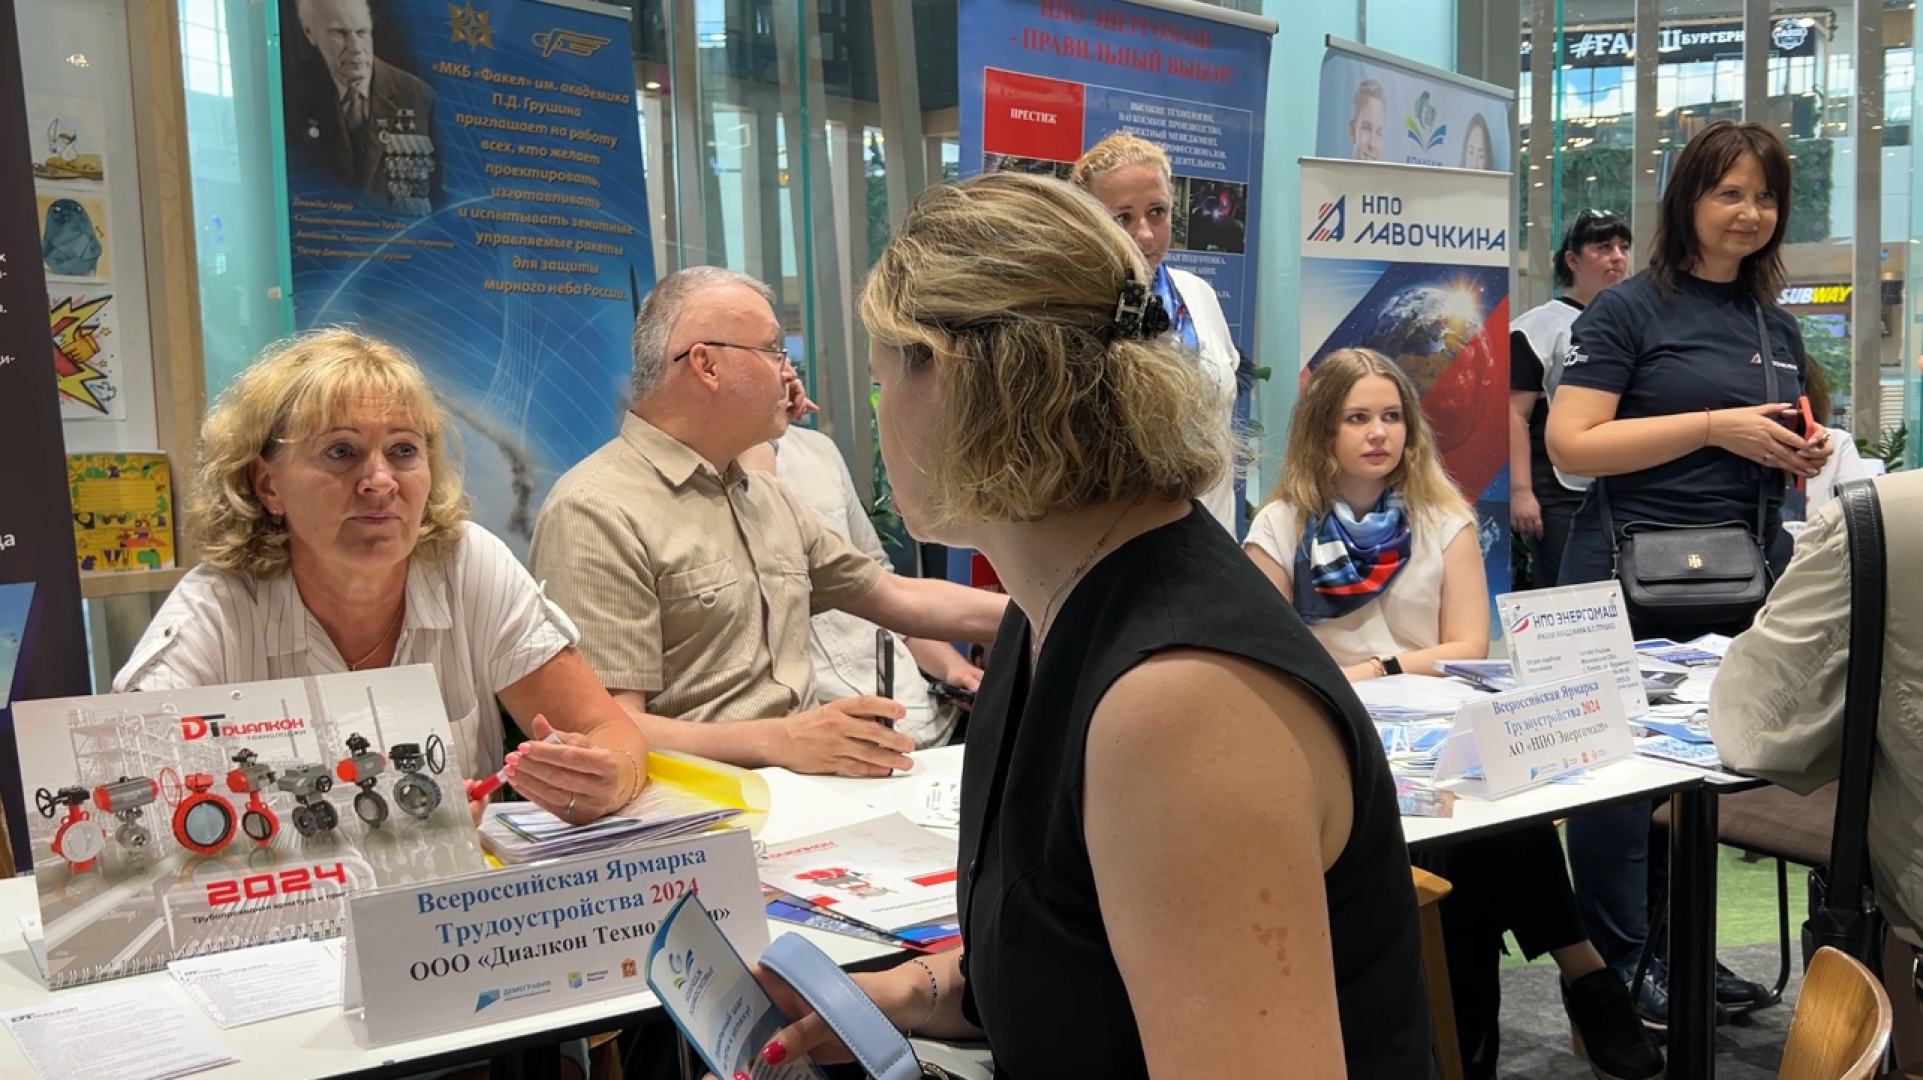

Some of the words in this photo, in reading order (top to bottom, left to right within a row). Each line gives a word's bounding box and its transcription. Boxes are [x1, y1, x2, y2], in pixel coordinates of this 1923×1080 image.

[1040, 0, 1087, 25] НПО
[1093, 6, 1212, 50] ЭНЕРГОМАШ
[1023, 28, 1162, 74] ПРАВИЛЬНЫЙ
[1168, 55, 1235, 86] ВЫБОР!
[432, 61, 471, 79] «МКБ
[474, 69, 533, 86] «Факел»
[535, 80, 558, 91] им.
[560, 83, 630, 104] академика
[492, 93, 521, 110] П.Д.
[524, 97, 582, 117] Грушина
[1010, 108, 1057, 125] ПРЕСТИЖ
[456, 113, 548, 135] приглашает
[551, 126, 567, 137] на
[569, 129, 618, 148] работу
[480, 140, 515, 155] всех,
[518, 144, 548, 156] кто
[550, 148, 601, 165] желает
[485, 163, 601, 187] проектировать,
[491, 187, 602, 209] изготавливать
[1362, 195, 1403, 215] НПО
[459, 208, 468, 218] и
[471, 209, 569, 227] испытывать
[572, 218, 635, 235] зенитные
[476, 232, 573, 249] управляемые
[576, 240, 624, 256] ракеты
[1354, 221, 1506, 251] ЛАВОЧКИНА
[513, 256, 538, 271] для
[542, 259, 600, 275] защиты
[484, 280, 546, 294] мирного
[548, 281, 581, 295] неба
[584, 284, 628, 299] России.
[1776, 285, 1854, 305] SUBWAY
[1533, 613, 1555, 628] НПО
[1556, 604, 1618, 625] ЭНЕРГОМАШ
[1492, 690, 1560, 715] Всероссийская
[1560, 681, 1599, 700] Ярмарка
[1504, 706, 1581, 737] Трудоустройства
[1581, 699, 1601, 715] 2024
[1509, 741, 1525, 757] АО
[1527, 733, 1556, 751] «НПО
[206, 862, 346, 906] 2024
[416, 867, 599, 915] Всероссийская
[606, 850, 707, 885] Ярмарка
[435, 889, 645, 948] Трудоустройства
[650, 877, 699, 904] 2024
[410, 952, 471, 983] ООО
[477, 934, 588, 970] «Диалкон
